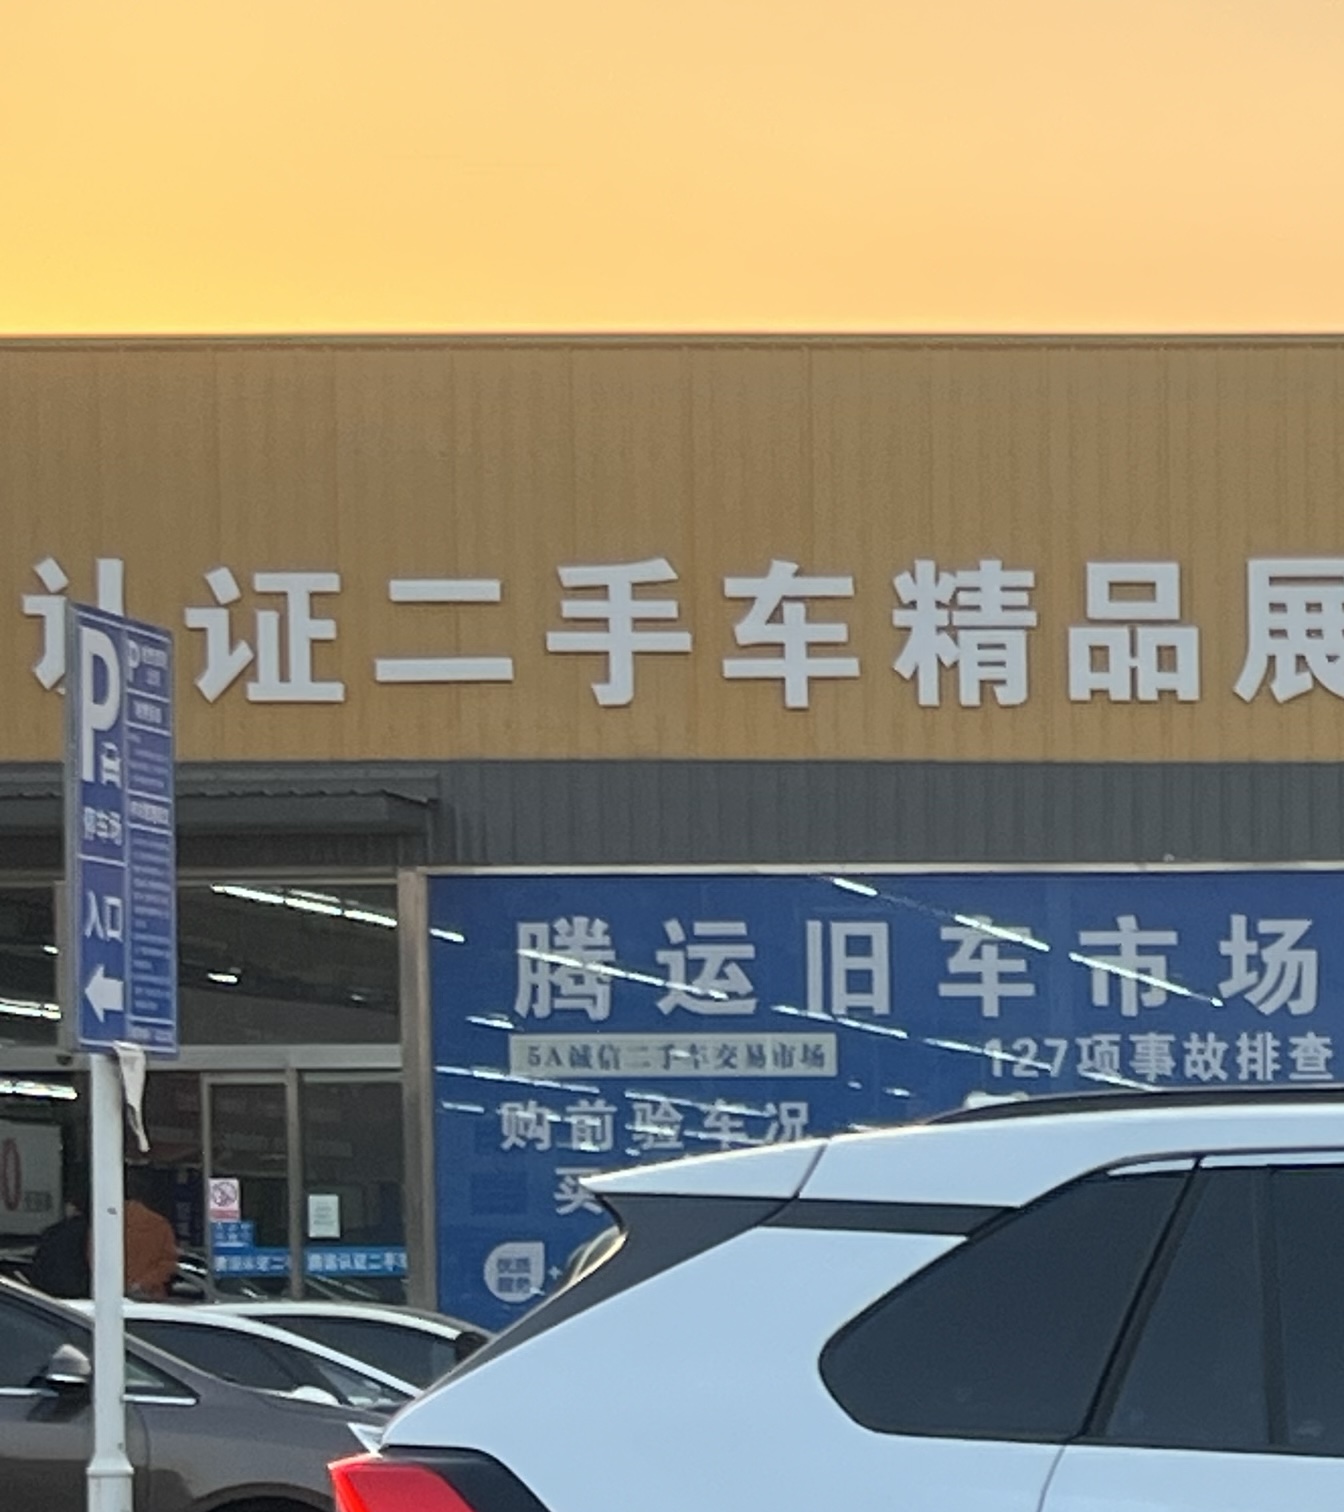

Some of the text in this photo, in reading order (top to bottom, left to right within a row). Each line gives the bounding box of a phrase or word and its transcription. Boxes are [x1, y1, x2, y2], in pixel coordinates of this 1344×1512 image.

[82, 625, 121, 782] P
[84, 891, 123, 942] 入口
[513, 915, 1318, 1020] 腾运旧车市场
[985, 1031, 1334, 1082] 127项事故排查
[499, 1098, 809, 1151] 购前验车况
